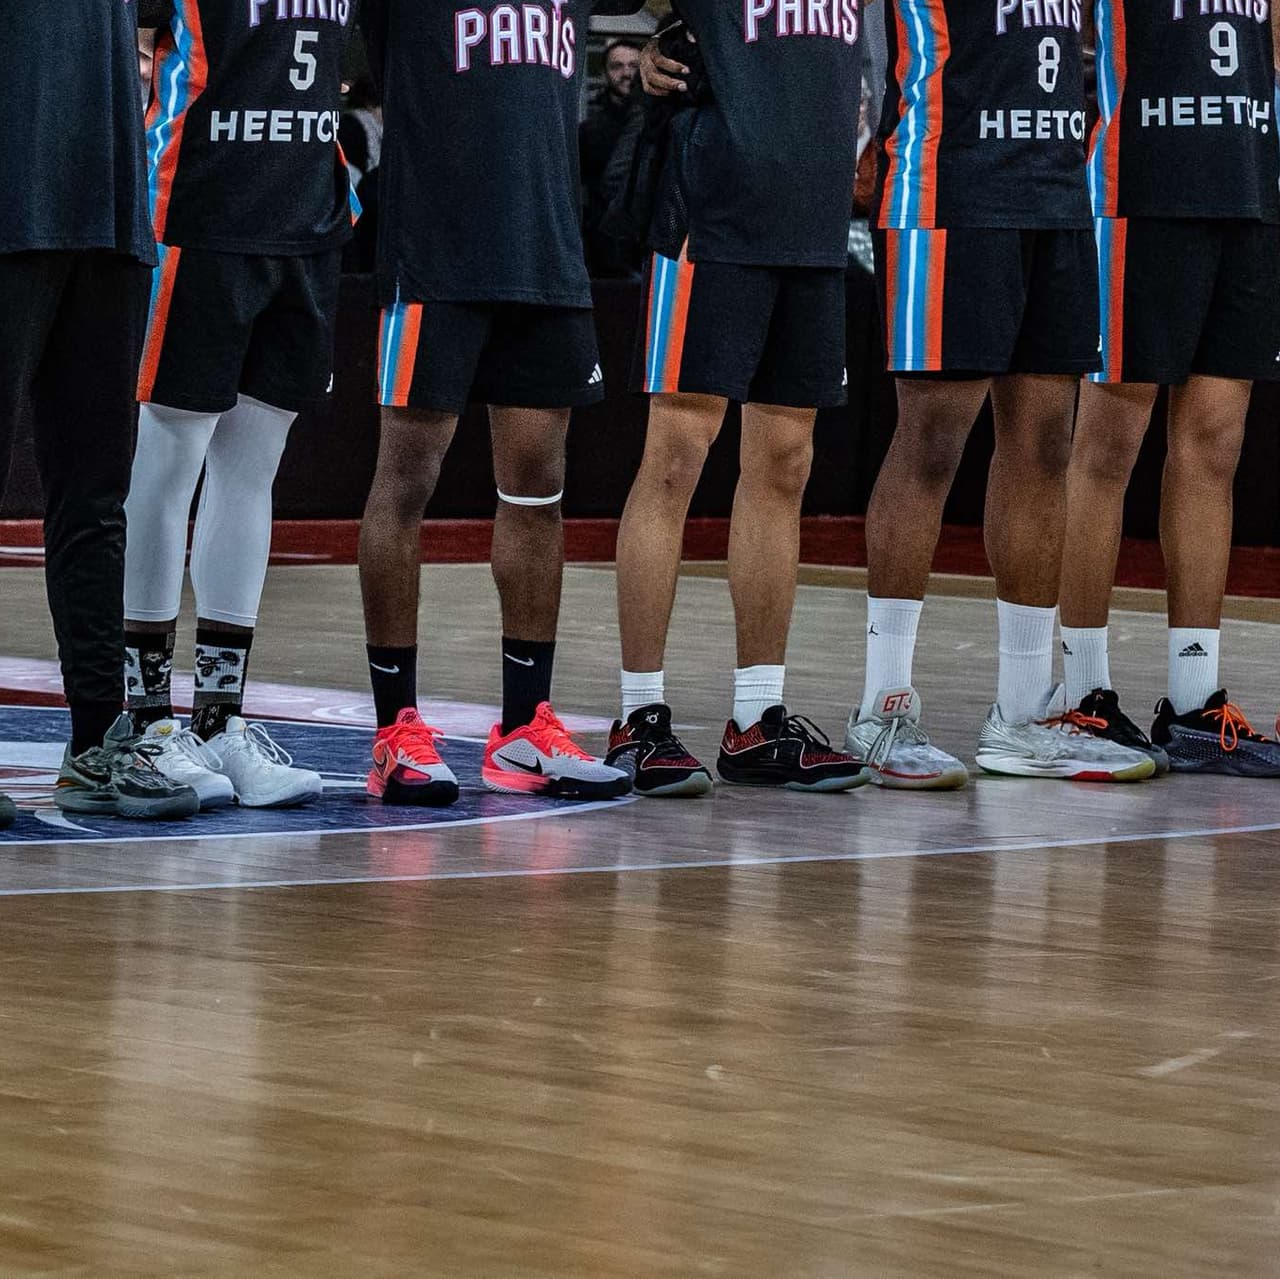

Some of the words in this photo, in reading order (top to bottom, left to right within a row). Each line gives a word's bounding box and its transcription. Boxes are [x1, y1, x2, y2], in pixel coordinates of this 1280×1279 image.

[289, 30, 319, 90] 5
[1038, 36, 1061, 93] 8
[1209, 21, 1239, 77] 9
[979, 109, 1086, 141] HEETC
